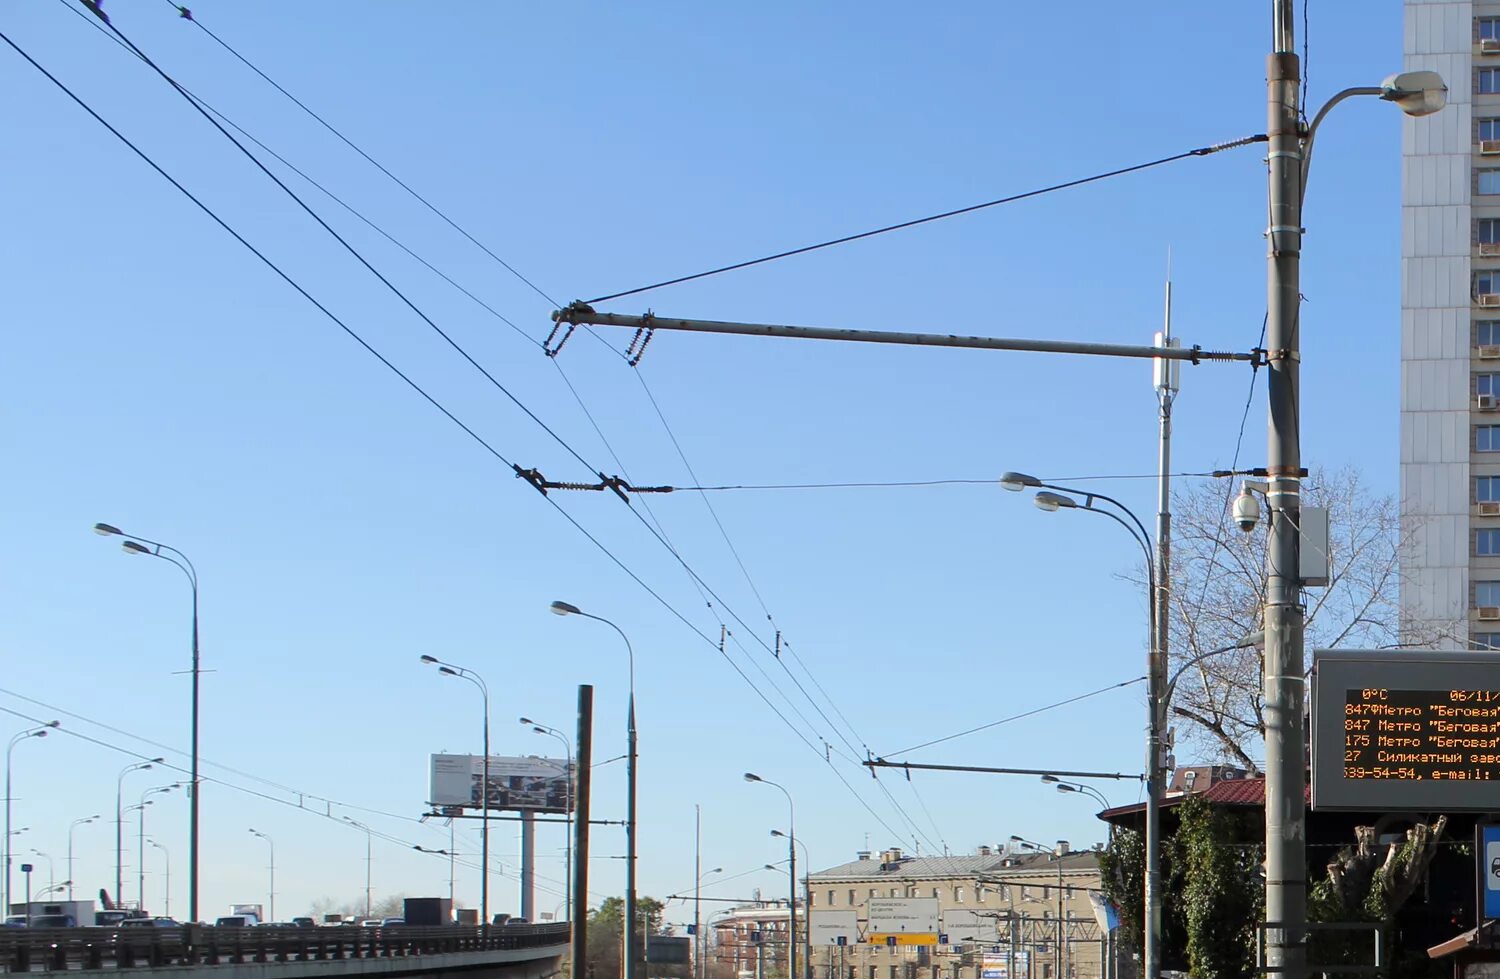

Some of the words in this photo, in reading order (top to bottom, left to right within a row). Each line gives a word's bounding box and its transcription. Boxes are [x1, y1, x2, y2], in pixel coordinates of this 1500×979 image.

[1362, 687, 1388, 700] 0°C
[1344, 719, 1370, 732] 847
[1378, 720, 1421, 732] Метро
[1344, 734, 1370, 747] 175
[1378, 734, 1420, 748] Метро
[1344, 750, 1361, 762] 27
[1377, 750, 1462, 763] Силикатный
[1432, 768, 1490, 780] e-mail:
